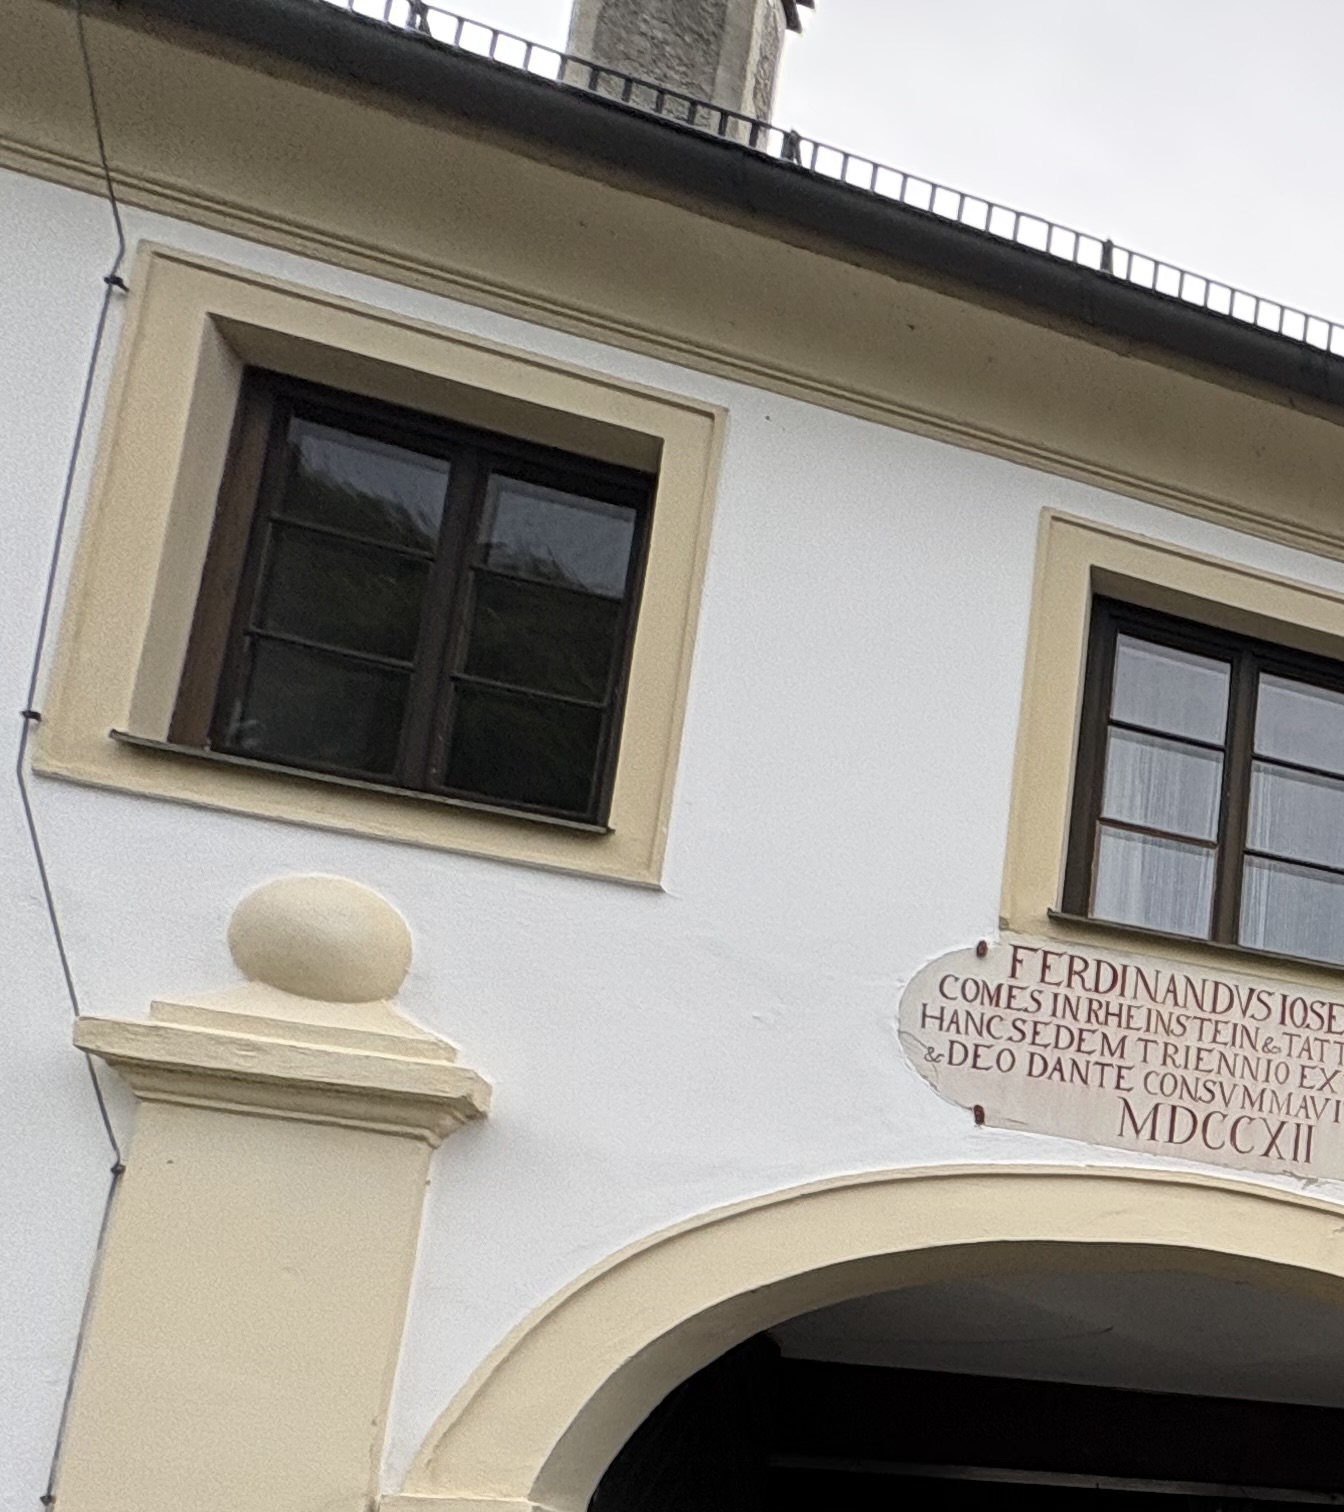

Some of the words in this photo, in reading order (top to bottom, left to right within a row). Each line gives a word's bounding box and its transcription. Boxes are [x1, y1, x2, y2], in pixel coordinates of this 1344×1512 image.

[938, 974, 1045, 1014] COMES
[1050, 992, 1081, 1021] IN
[1008, 943, 1276, 1022] FERDINANDVS
[920, 1003, 1004, 1041] HANC
[1008, 1017, 1128, 1060] SEDEM
[1136, 1037, 1290, 1085] TRIENNIO
[947, 1039, 1016, 1073] DEO
[1027, 1052, 1134, 1092] DANTE
[1116, 1096, 1314, 1163] MDCCXII
